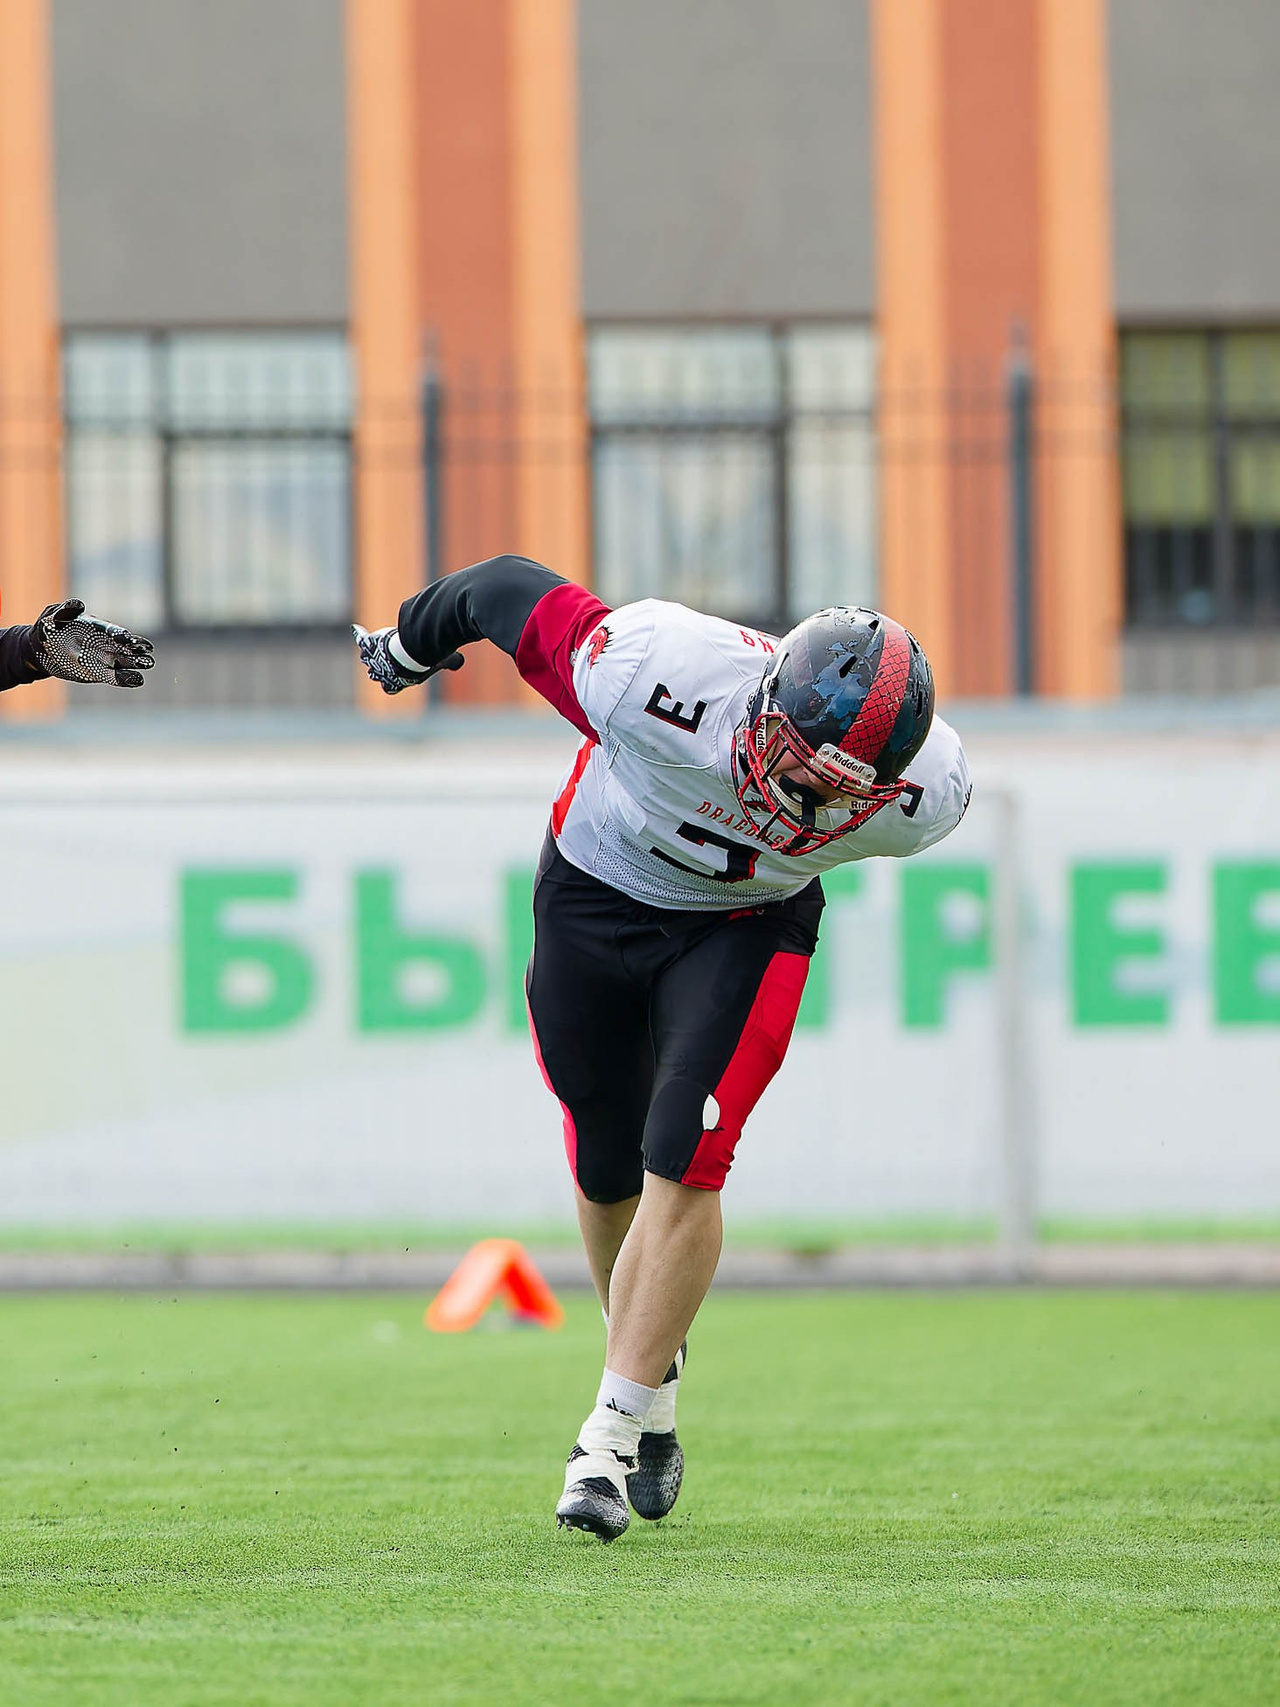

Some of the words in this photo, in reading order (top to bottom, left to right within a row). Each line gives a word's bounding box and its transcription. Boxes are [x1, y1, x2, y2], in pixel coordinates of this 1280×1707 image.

[643, 682, 708, 734] 3
[757, 721, 766, 756] Ridde
[831, 751, 867, 775] Riddell
